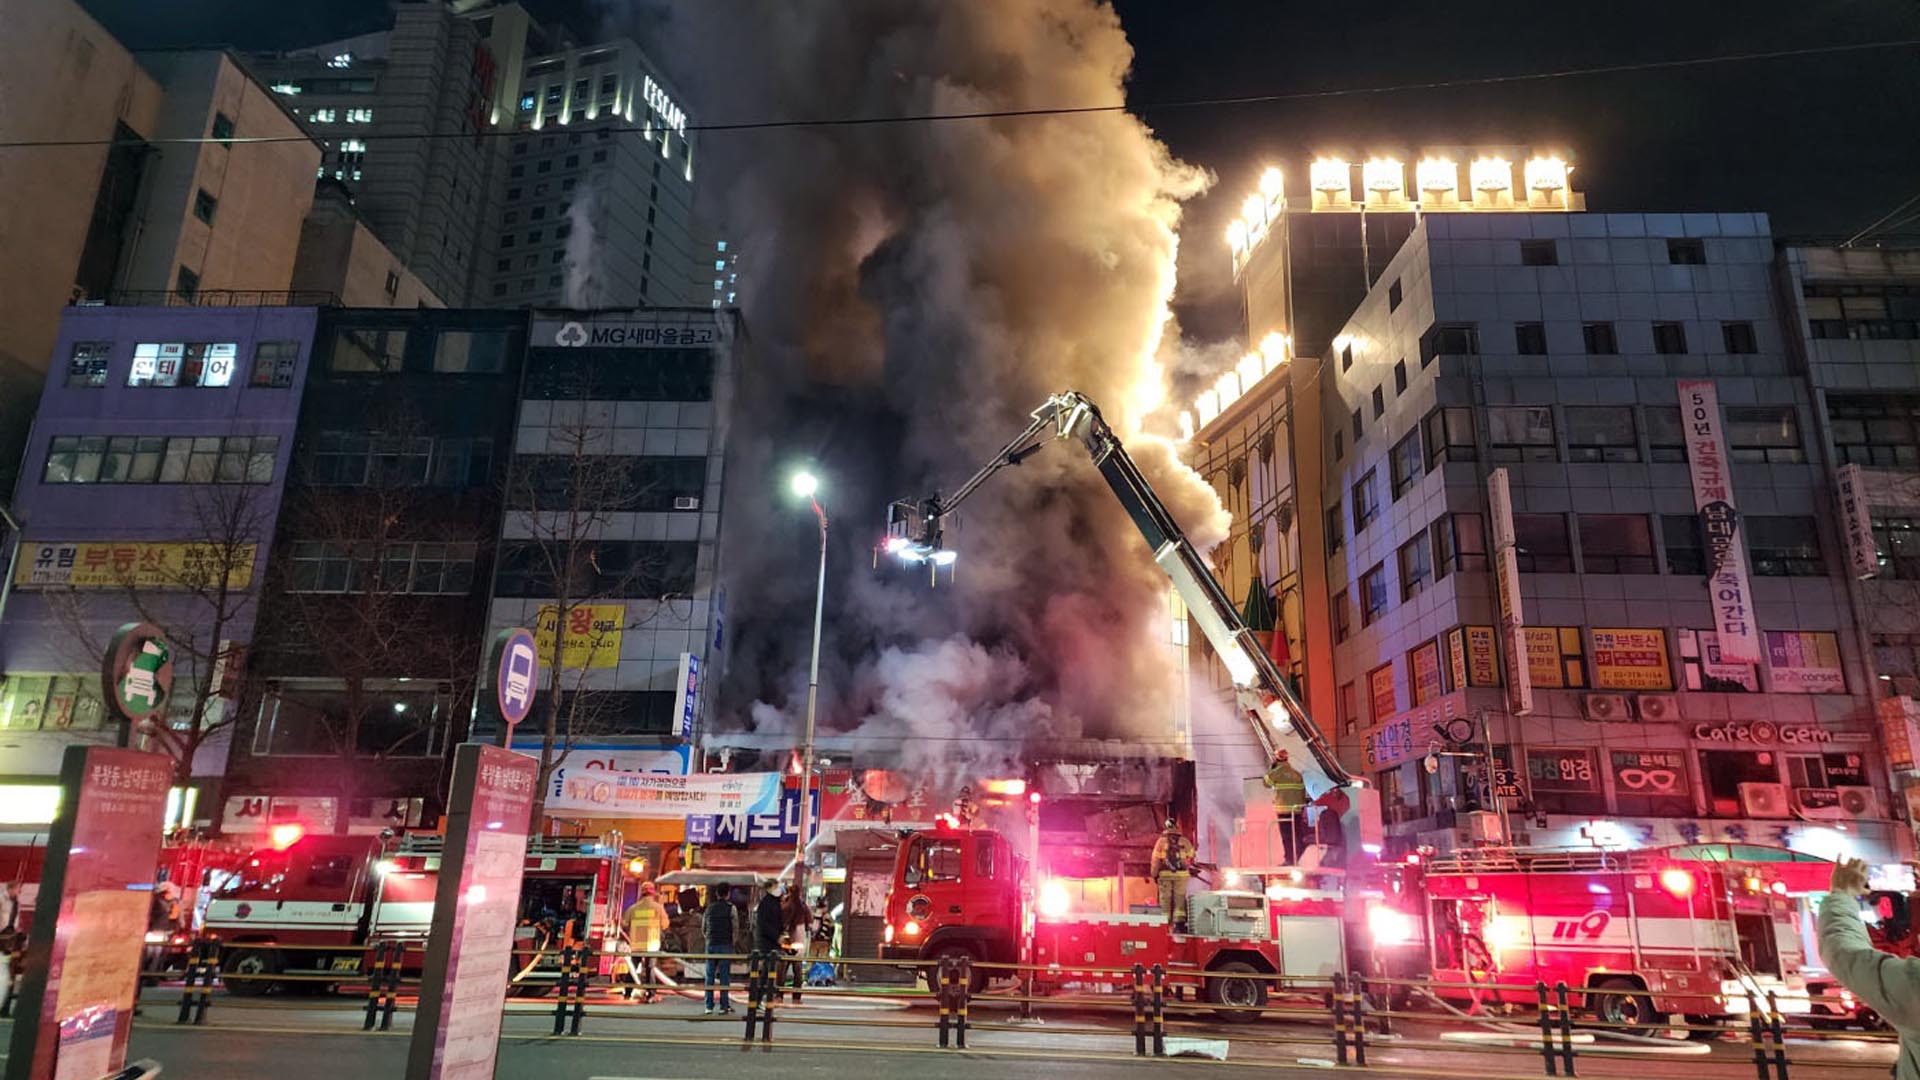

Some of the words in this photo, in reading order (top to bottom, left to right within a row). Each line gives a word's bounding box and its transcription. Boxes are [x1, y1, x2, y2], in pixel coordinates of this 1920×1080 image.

[643, 74, 688, 139] L'ESCAPE
[84, 548, 168, 573] 부동산
[1616, 634, 1659, 649] 부동산
[1473, 645, 1493, 684] 부동산
[1695, 721, 1750, 743] Cafe
[1779, 724, 1833, 744] Gem
[1494, 785, 1517, 796] ATE
[1552, 911, 1611, 940] 119
